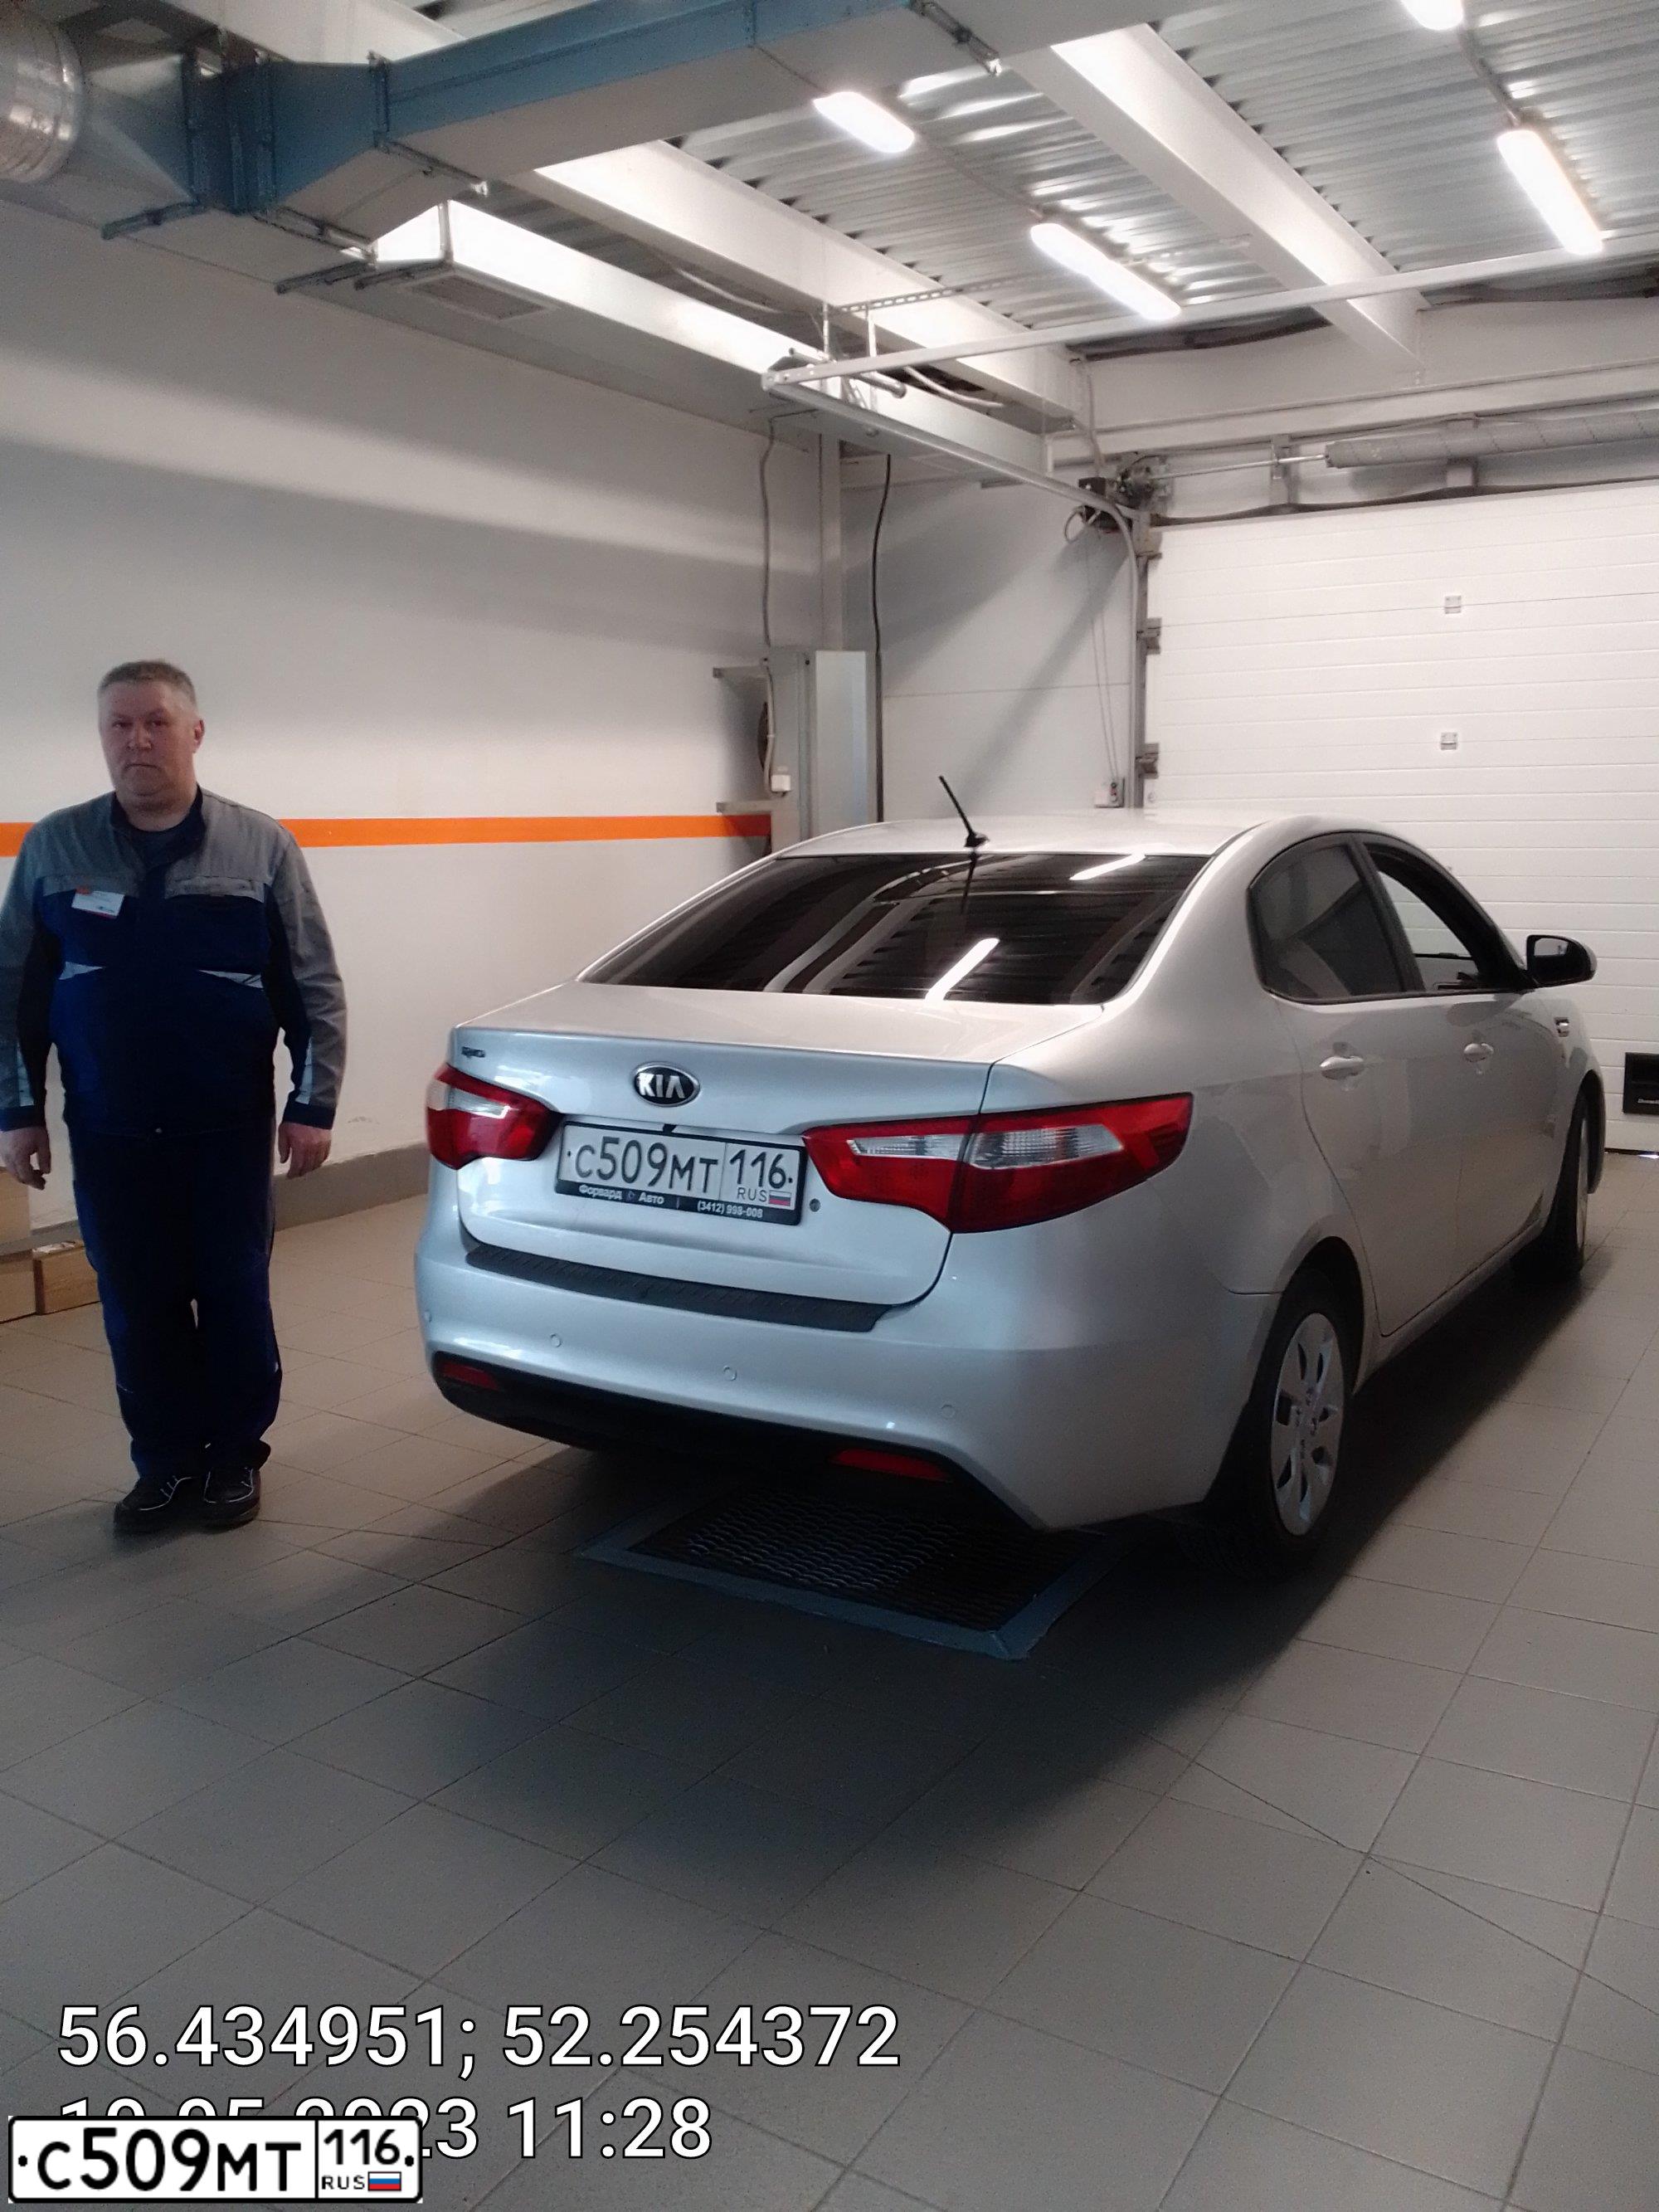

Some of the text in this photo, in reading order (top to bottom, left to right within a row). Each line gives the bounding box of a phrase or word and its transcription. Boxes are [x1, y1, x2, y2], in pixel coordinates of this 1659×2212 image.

[639, 1073, 685, 1098] KIA
[729, 1148, 787, 1189] 116
[638, 1191, 664, 1205] Авто
[737, 1186, 767, 1202] RUS
